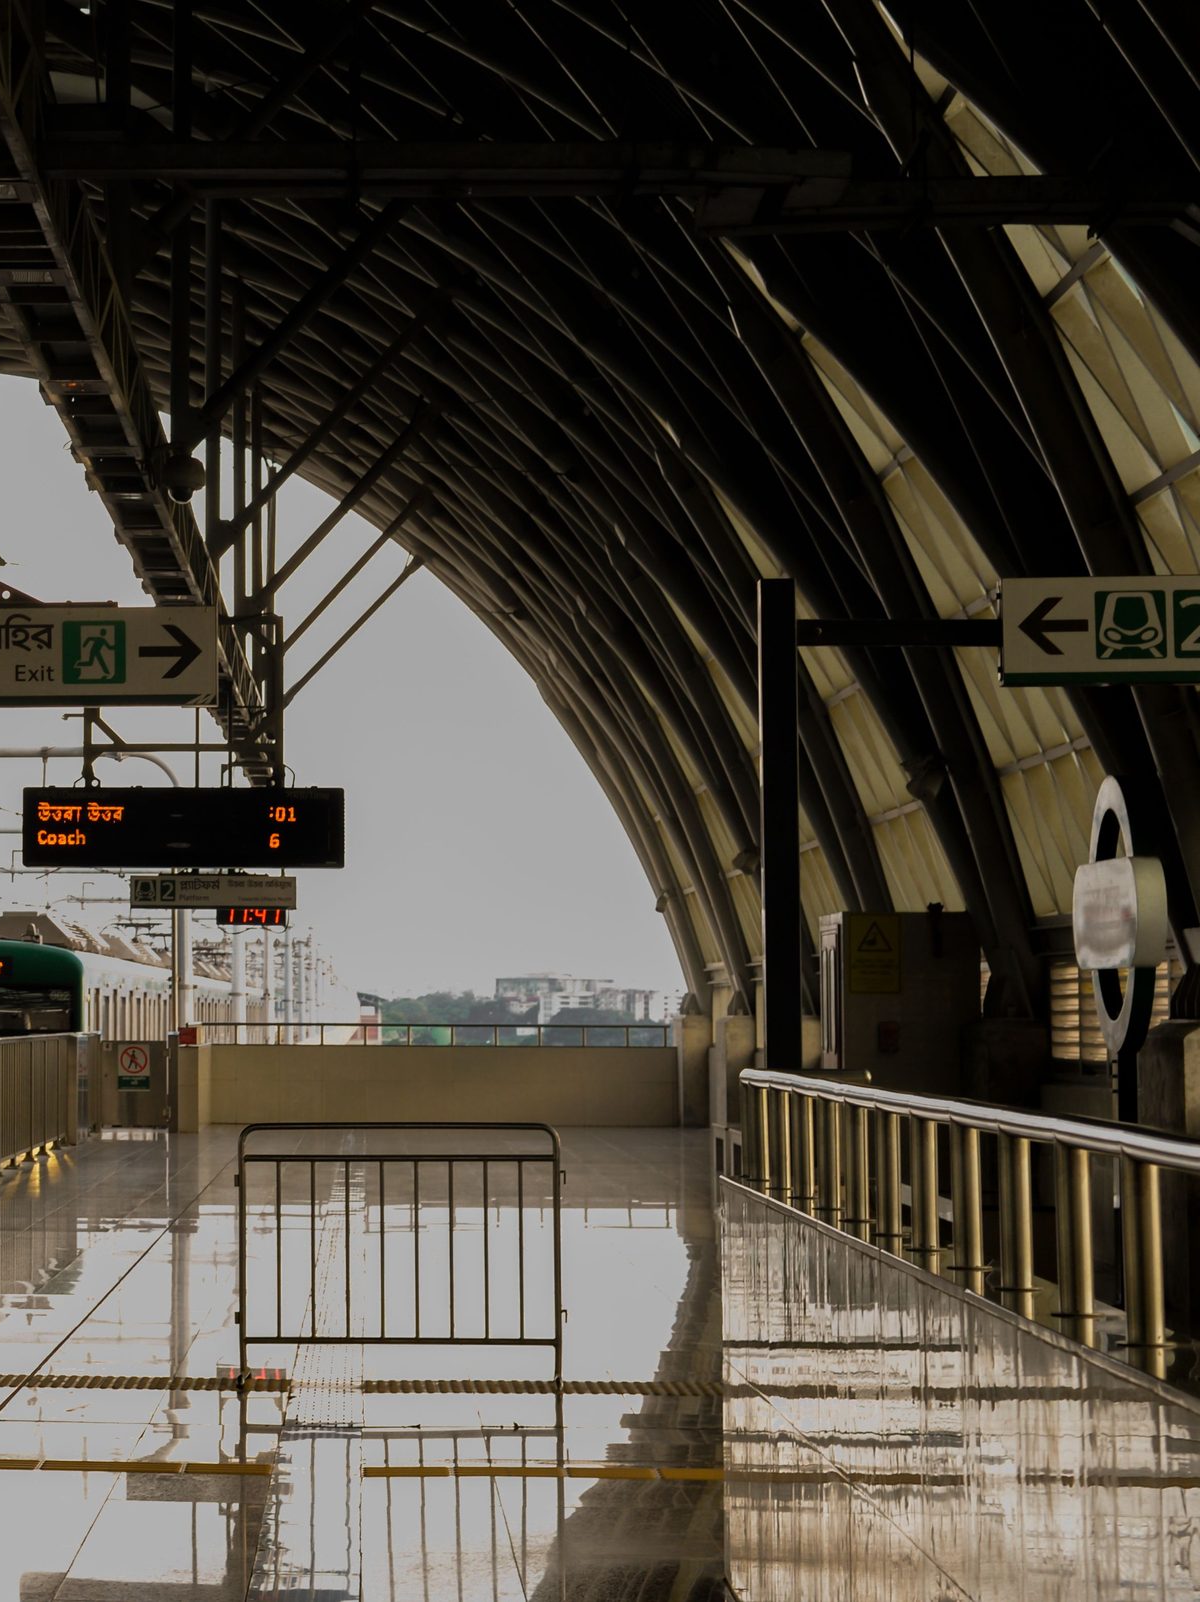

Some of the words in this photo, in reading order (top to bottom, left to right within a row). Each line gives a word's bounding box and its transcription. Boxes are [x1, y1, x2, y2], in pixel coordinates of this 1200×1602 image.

[14, 663, 55, 683] Exit
[36, 829, 87, 846] Coach
[268, 832, 281, 849] 6
[161, 881, 175, 901] 2
[179, 876, 220, 891] প্ল্যাটফর্ম
